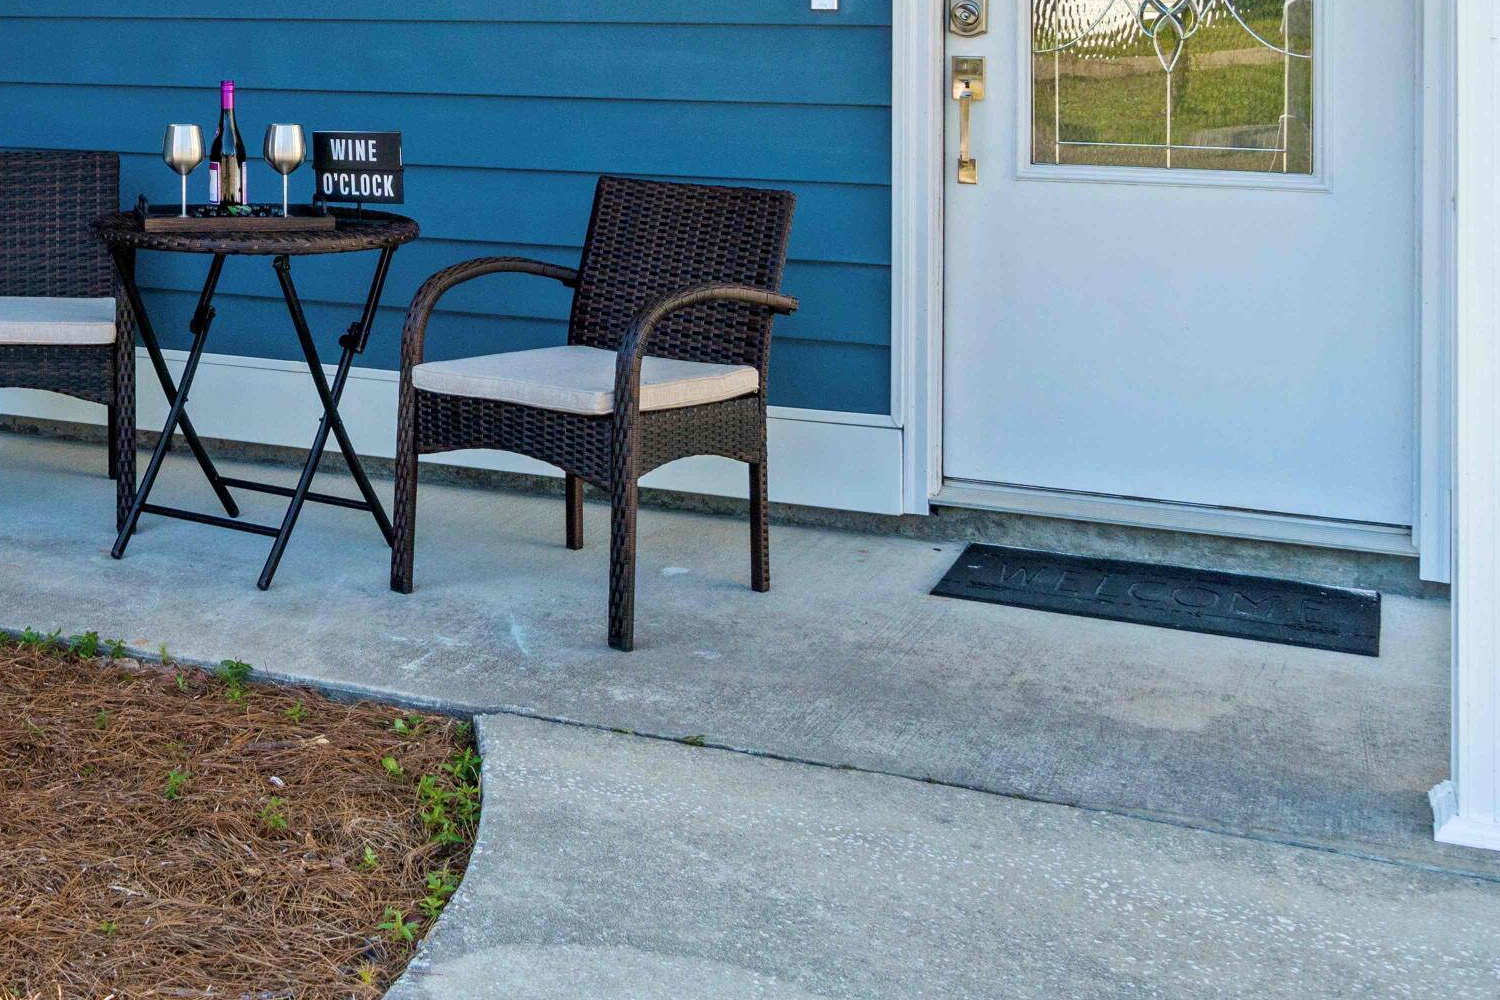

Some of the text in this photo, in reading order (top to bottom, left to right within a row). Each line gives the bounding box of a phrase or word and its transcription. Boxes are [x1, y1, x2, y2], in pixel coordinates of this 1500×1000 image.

[330, 138, 378, 162] WINE
[322, 172, 395, 197] O'CLOCK
[1000, 563, 1326, 624] WELCOME
